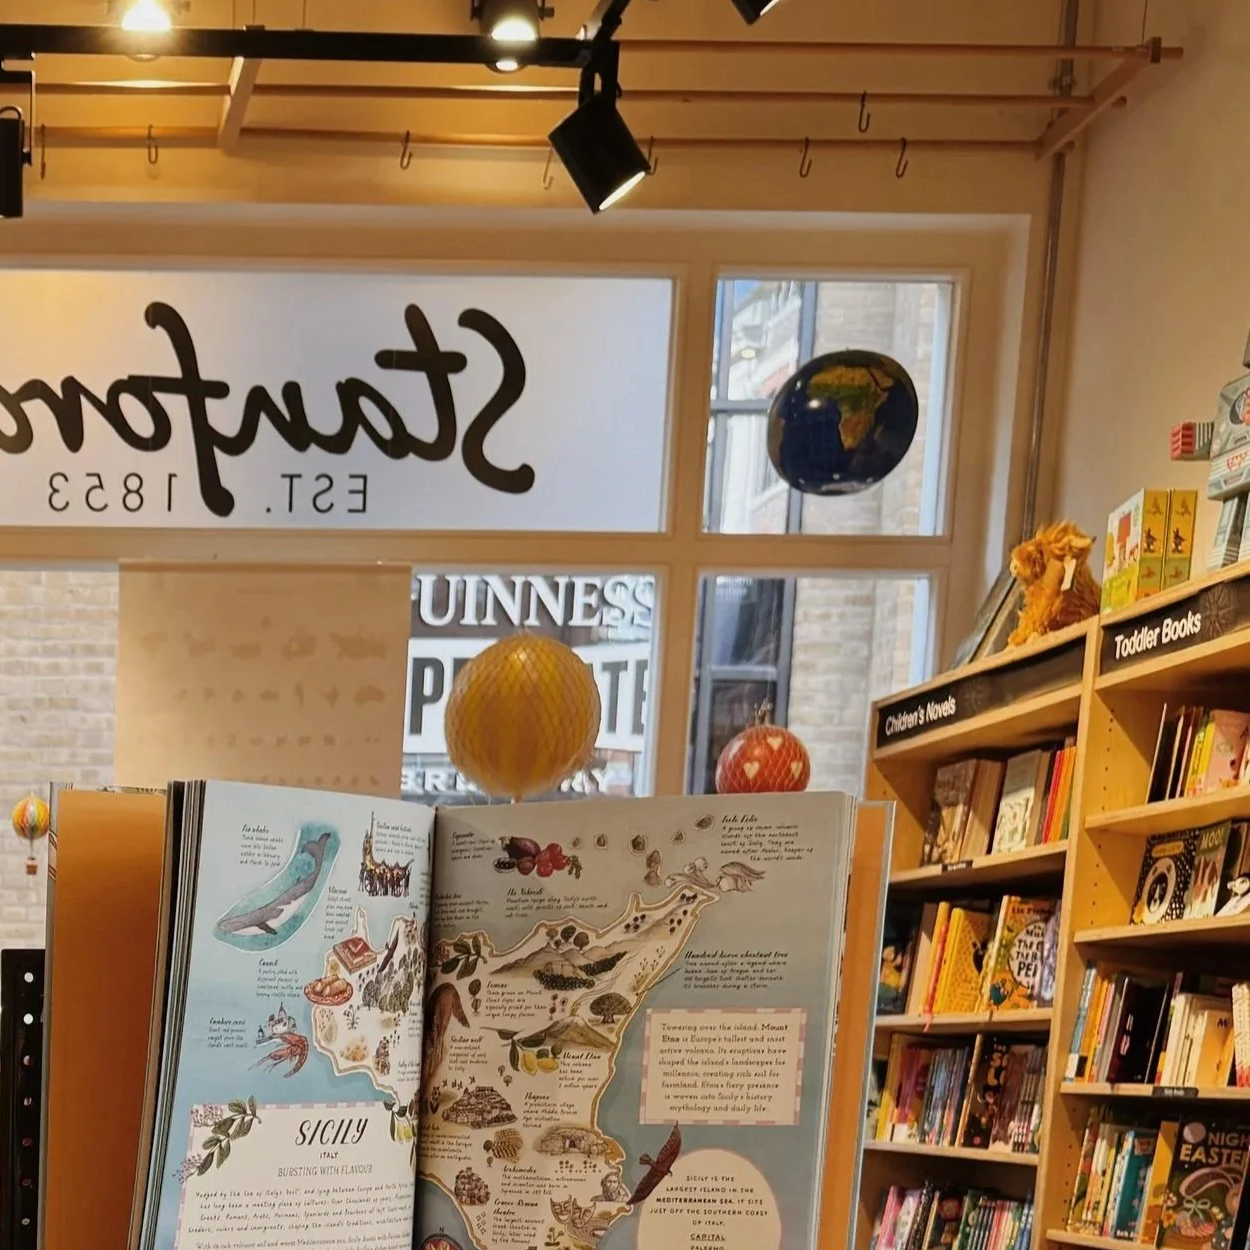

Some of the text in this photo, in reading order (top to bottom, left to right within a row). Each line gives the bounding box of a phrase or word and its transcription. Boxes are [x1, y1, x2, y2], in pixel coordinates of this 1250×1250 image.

[412, 574, 656, 627] UINNESS
[1114, 611, 1201, 660] Toddler Books
[885, 695, 956, 736] Children's Novels
[295, 1118, 369, 1146] SICILY
[278, 1164, 373, 1177] BURSTING WITH FLAVOUR
